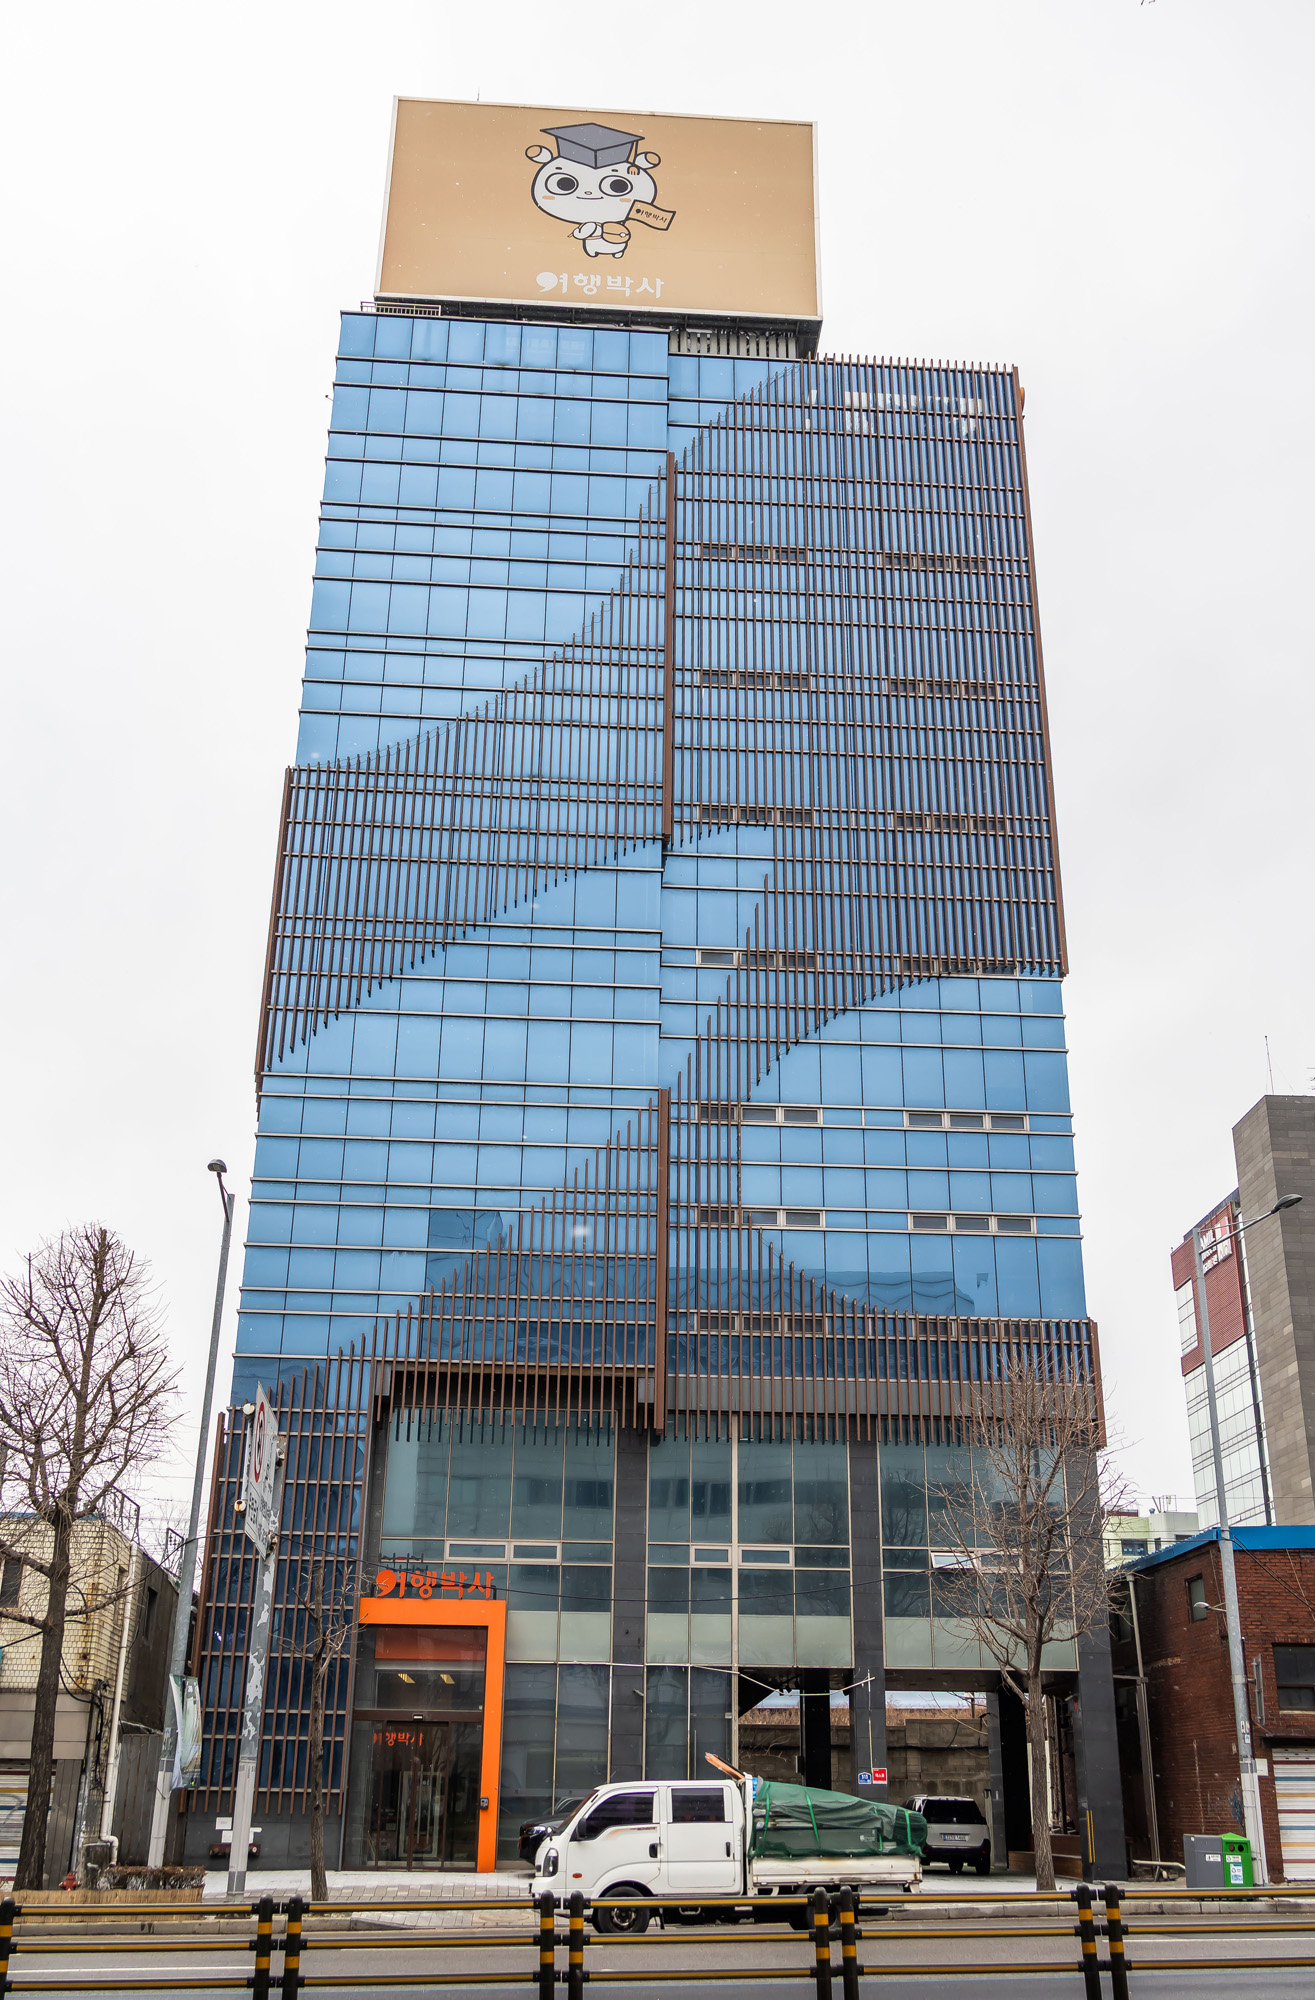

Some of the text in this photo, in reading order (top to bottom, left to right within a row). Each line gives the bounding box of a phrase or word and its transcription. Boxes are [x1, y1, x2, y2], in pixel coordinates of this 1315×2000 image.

[635, 208, 668, 223] 여행박사
[535, 271, 665, 299] 여행박사
[375, 1569, 495, 1599] 여행박사
